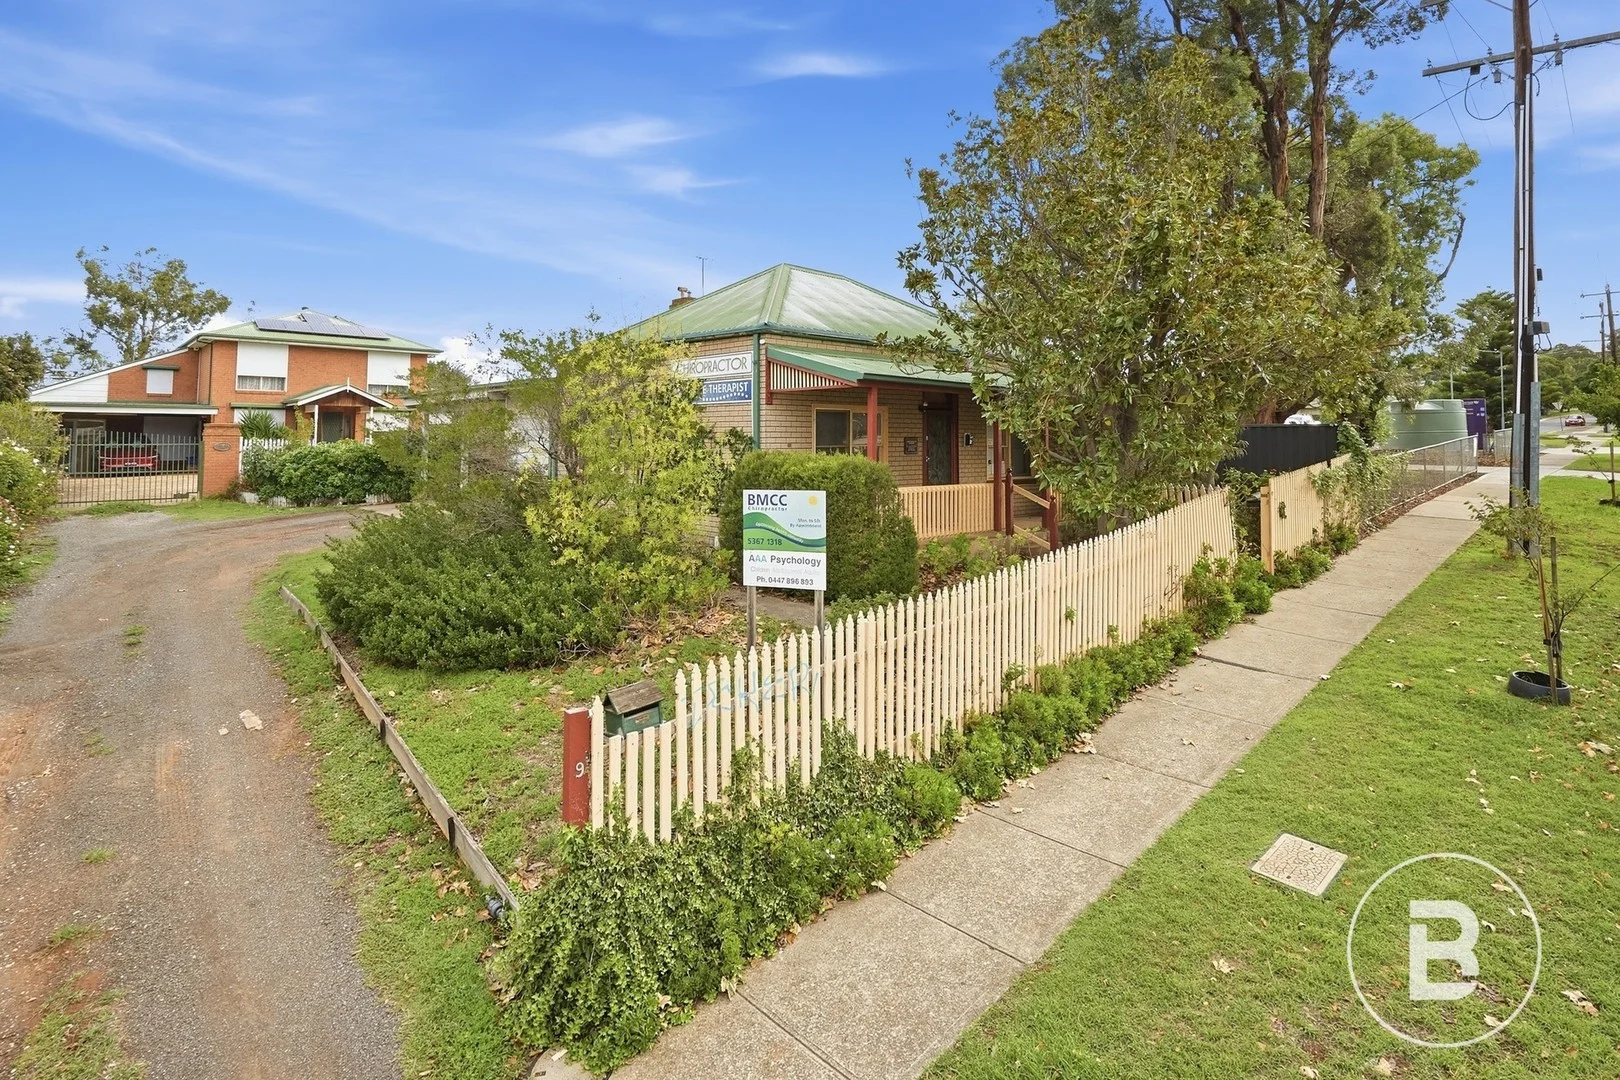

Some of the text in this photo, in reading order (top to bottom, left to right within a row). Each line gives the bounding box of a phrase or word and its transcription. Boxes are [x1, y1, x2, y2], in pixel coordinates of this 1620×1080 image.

[709, 381, 748, 393] THERAPIST
[748, 494, 787, 506] BMCC
[767, 538, 782, 546] 1318
[749, 554, 821, 567] AAA Psychology
[768, 576, 785, 584] 0447
[786, 577, 800, 585] 896
[575, 761, 584, 778] 9
